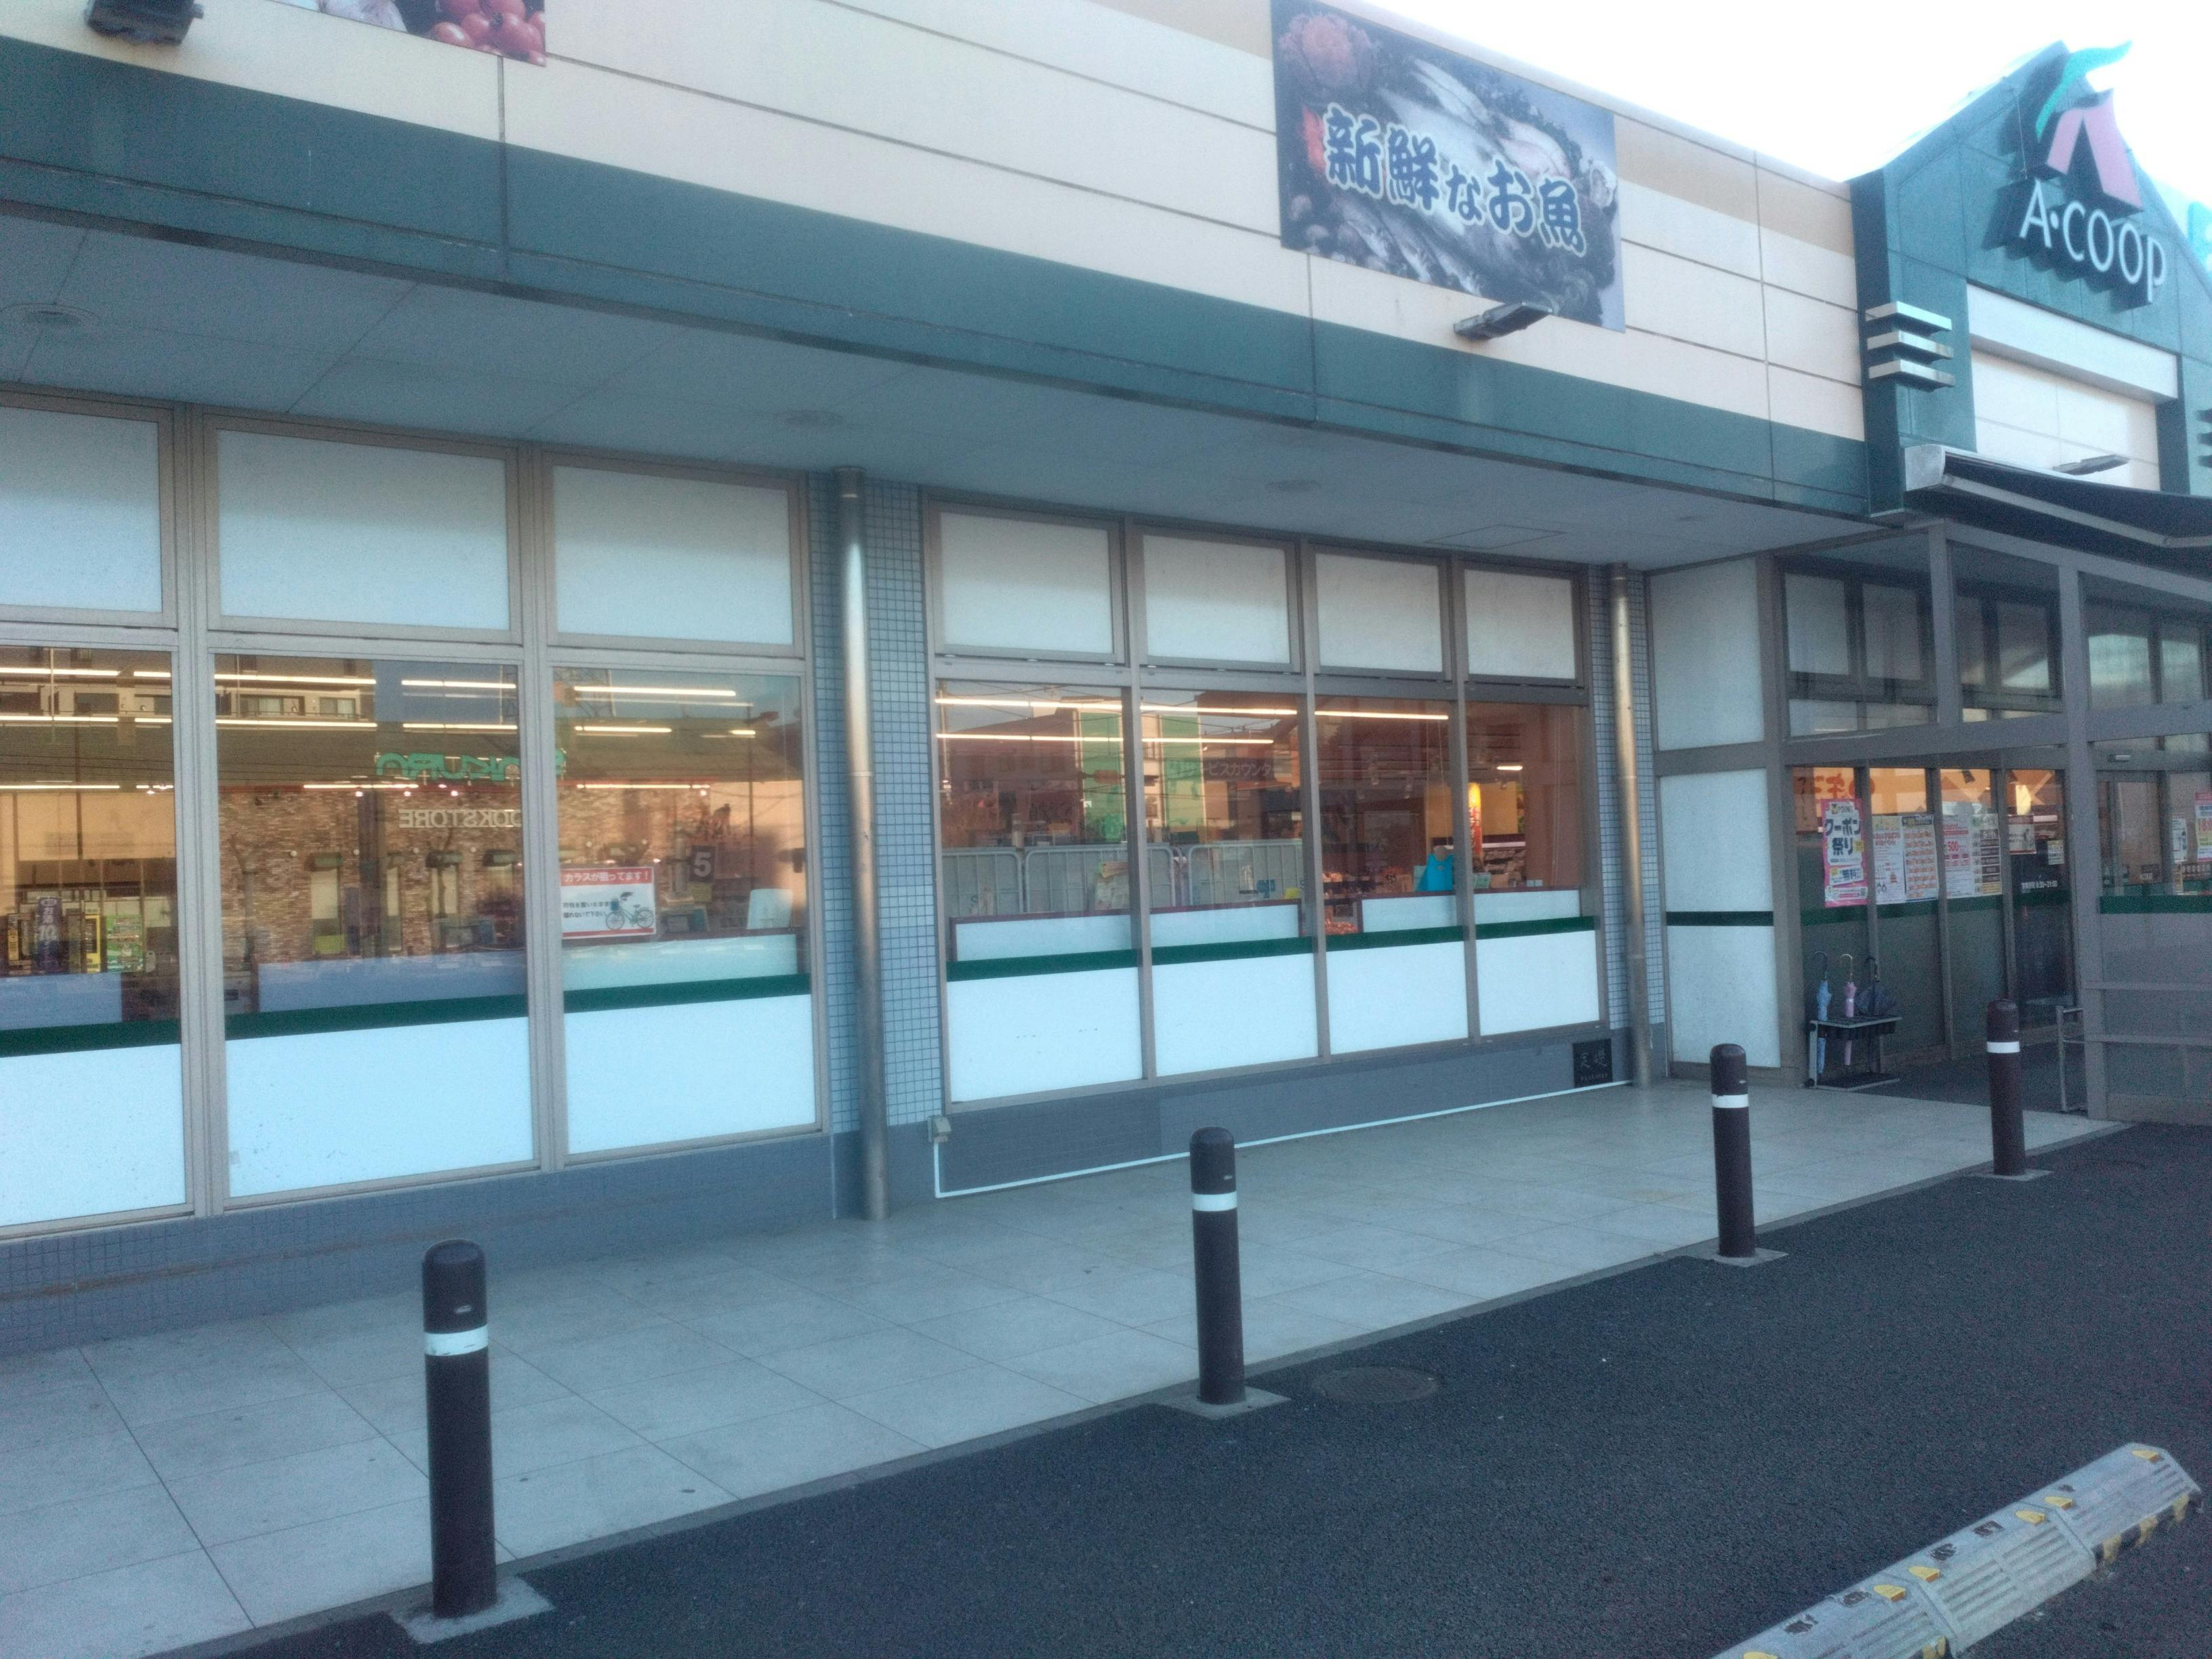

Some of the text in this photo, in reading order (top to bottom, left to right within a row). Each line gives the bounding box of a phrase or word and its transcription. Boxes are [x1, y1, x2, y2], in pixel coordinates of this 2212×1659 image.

[1323, 103, 1586, 257] 新鮮なお魚
[1824, 817, 1861, 837] クーポン
[1832, 838, 1853, 856] 祭り
[693, 851, 712, 877] 5
